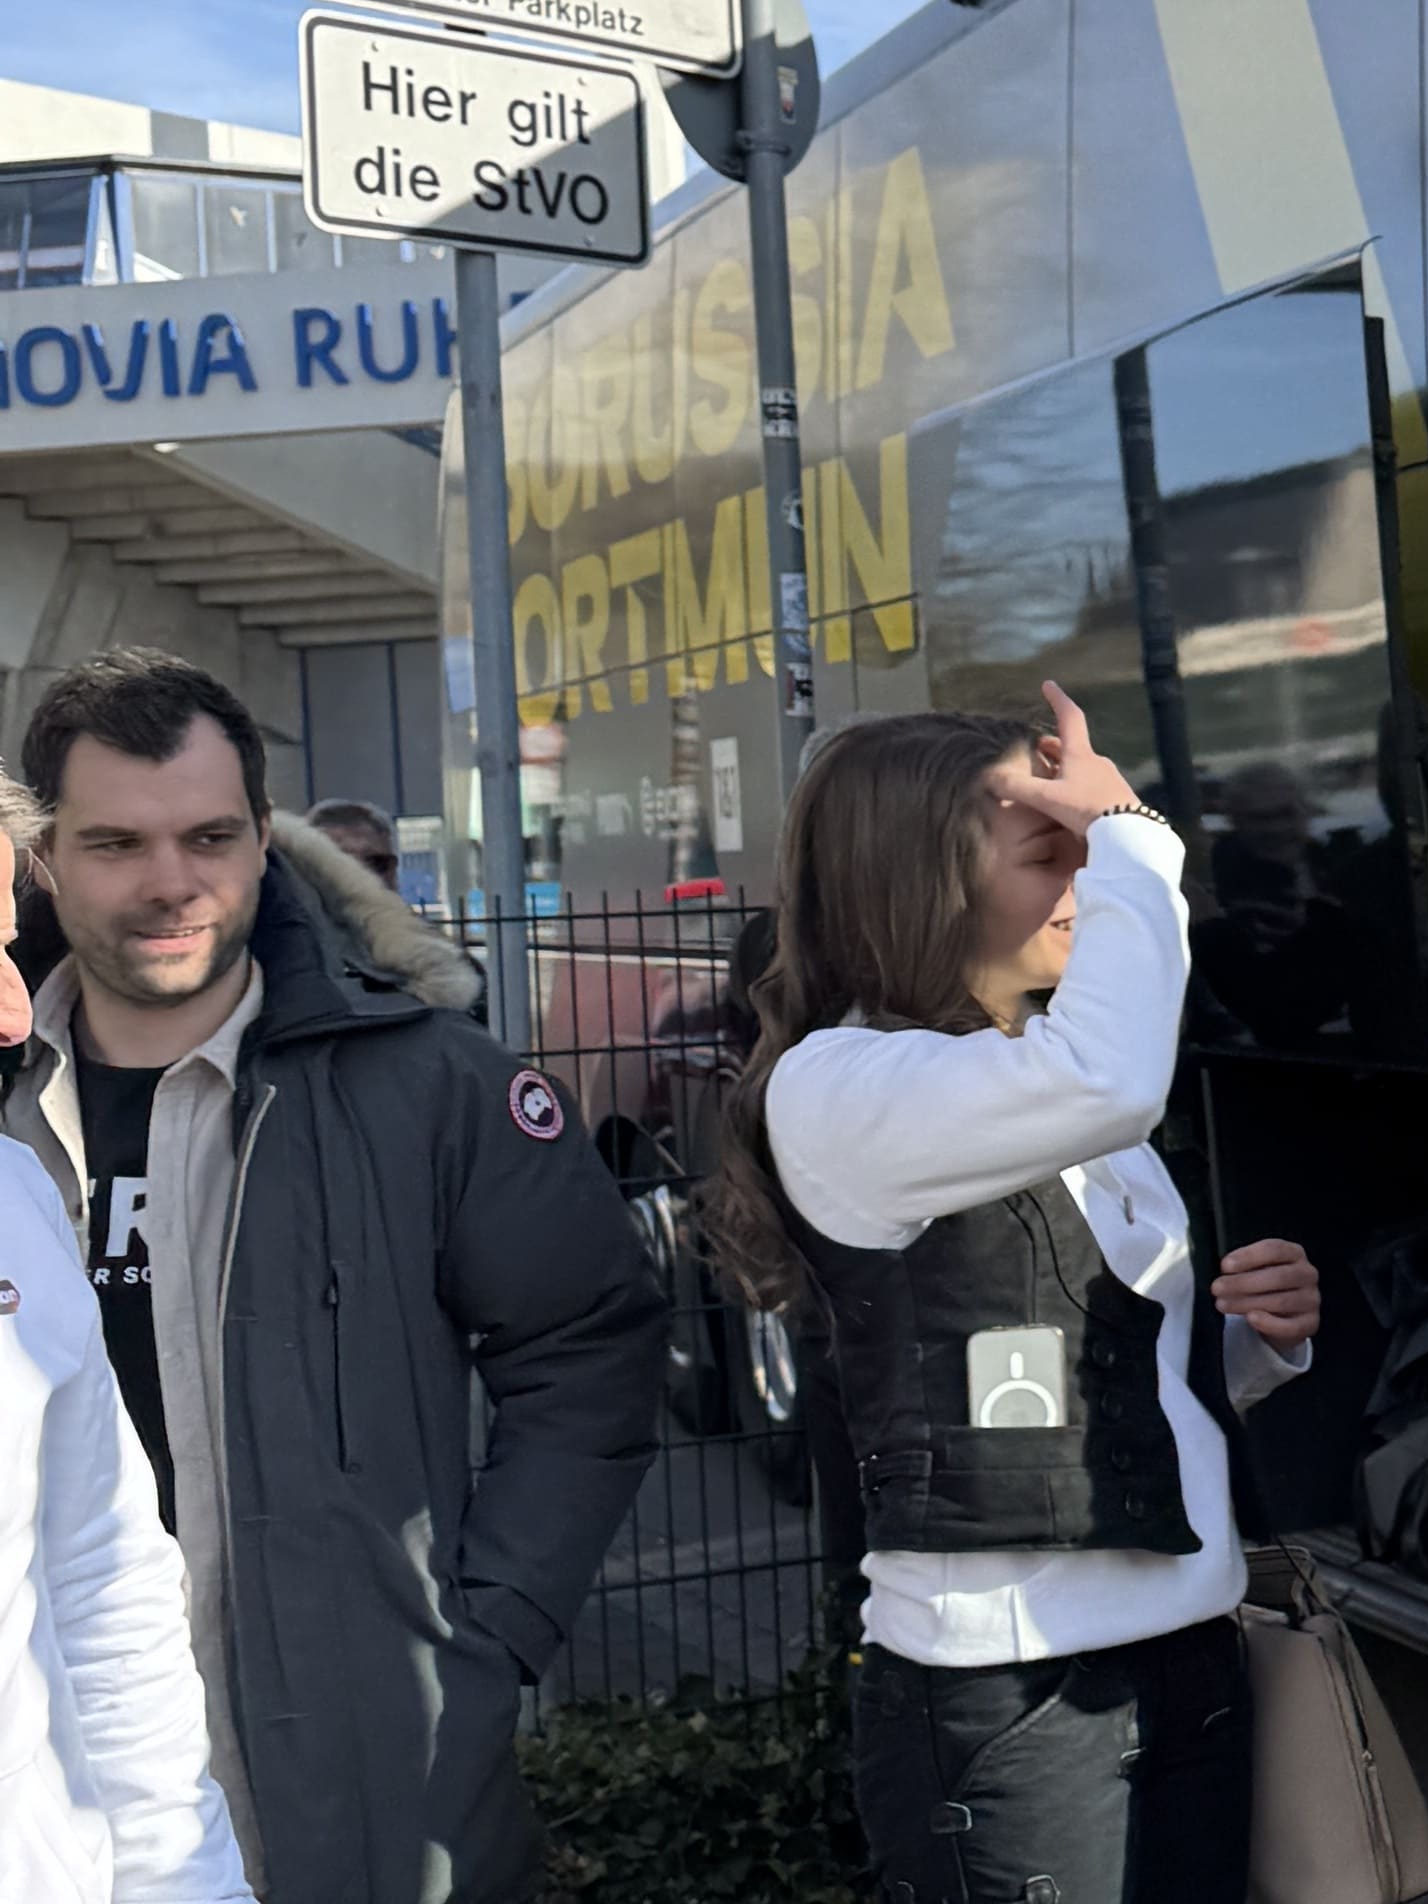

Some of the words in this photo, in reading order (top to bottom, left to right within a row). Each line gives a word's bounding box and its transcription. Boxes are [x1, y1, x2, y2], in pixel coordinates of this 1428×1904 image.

[362, 61, 477, 125] Hier
[507, 90, 591, 147] gilt
[354, 145, 441, 202] die
[472, 160, 609, 226] StVO
